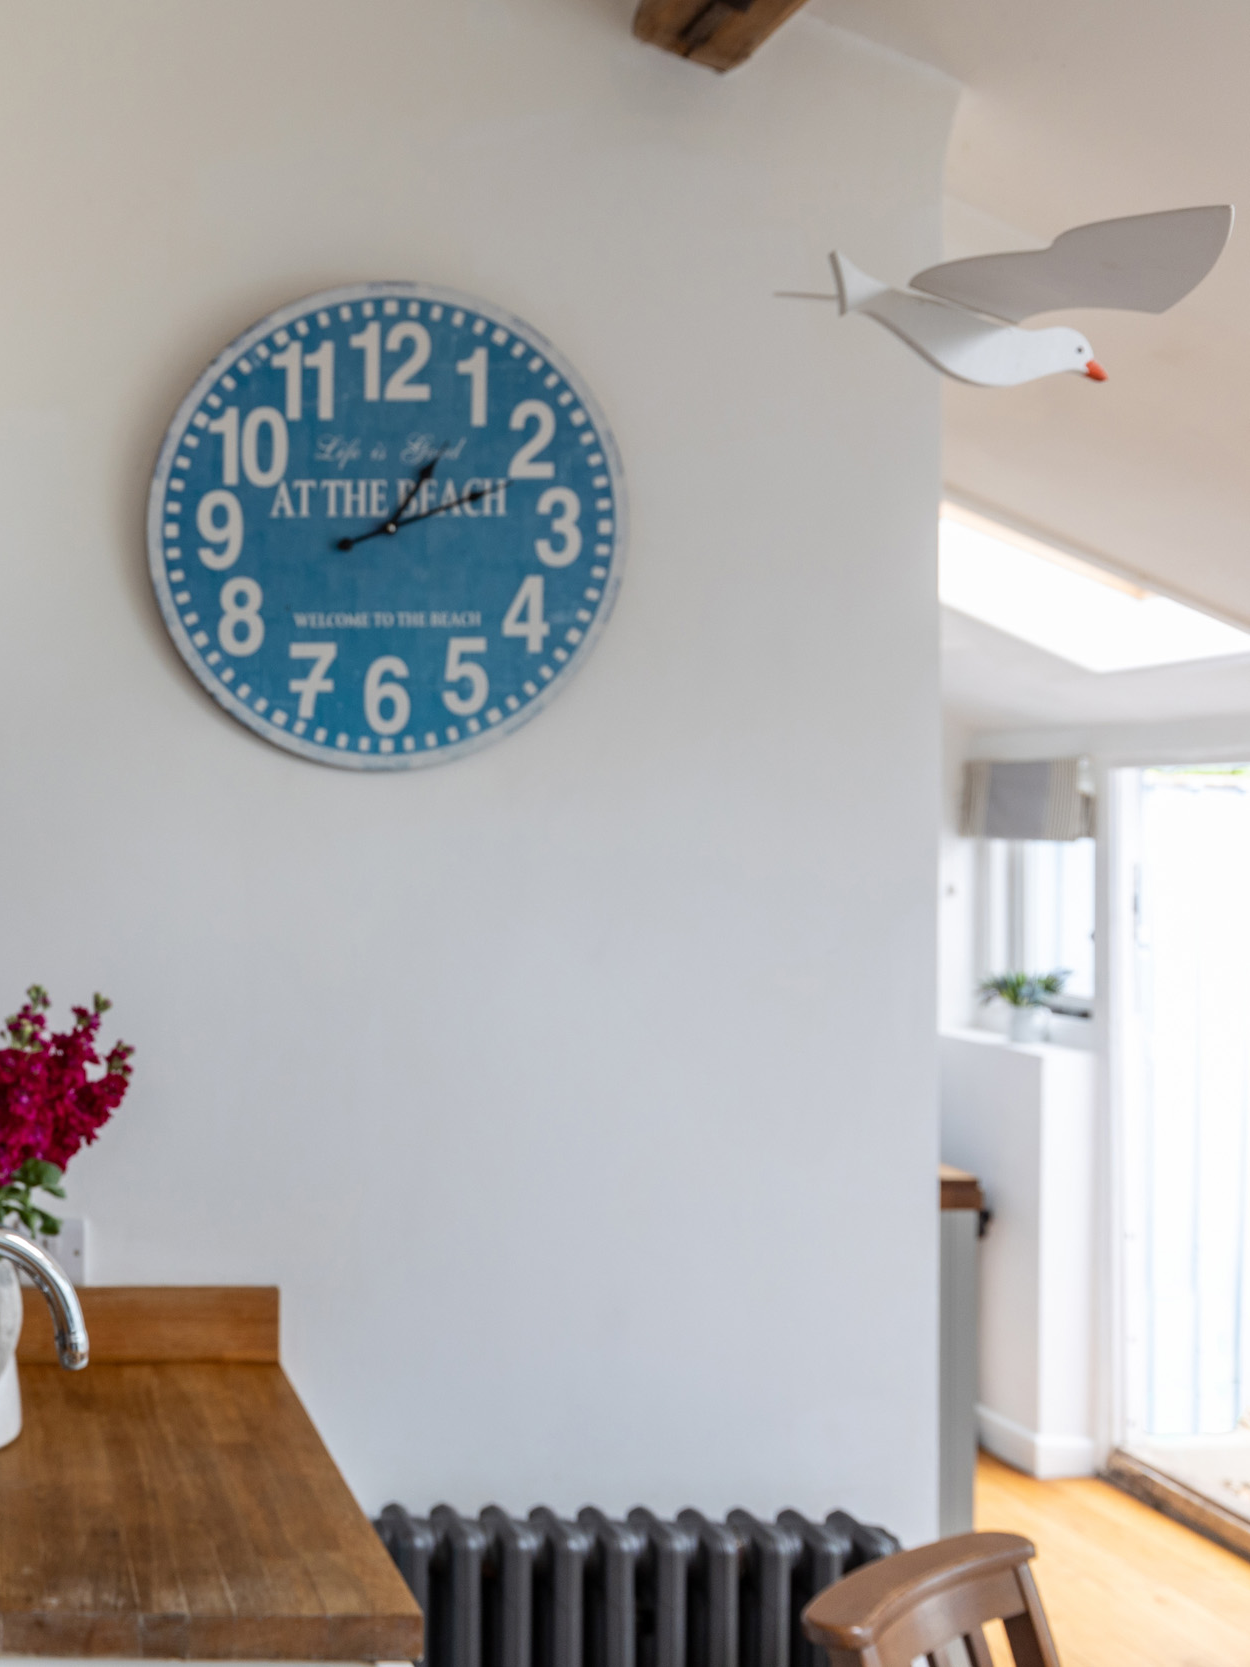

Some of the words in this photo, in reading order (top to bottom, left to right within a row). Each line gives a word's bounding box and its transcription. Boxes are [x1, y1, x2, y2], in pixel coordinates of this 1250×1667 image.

[272, 341, 335, 421] 11
[350, 322, 432, 402] 12
[457, 348, 488, 427] 1
[209, 406, 288, 487] 10
[315, 434, 362, 471] Life
[370, 441, 388, 461] is
[508, 399, 556, 480] 2
[197, 490, 244, 571] 9
[270, 479, 316, 518] AT
[321, 478, 390, 518] THE
[396, 477, 508, 518] BEACH
[535, 487, 582, 567] 3
[218, 577, 265, 657] 8
[293, 611, 371, 629] WELCOME
[373, 611, 394, 628] TO
[395, 611, 428, 628] THE
[429, 611, 482, 628] BEACH
[502, 574, 550, 654] 4
[288, 642, 338, 720] 7
[364, 656, 411, 735] 6
[442, 637, 489, 716] 5
